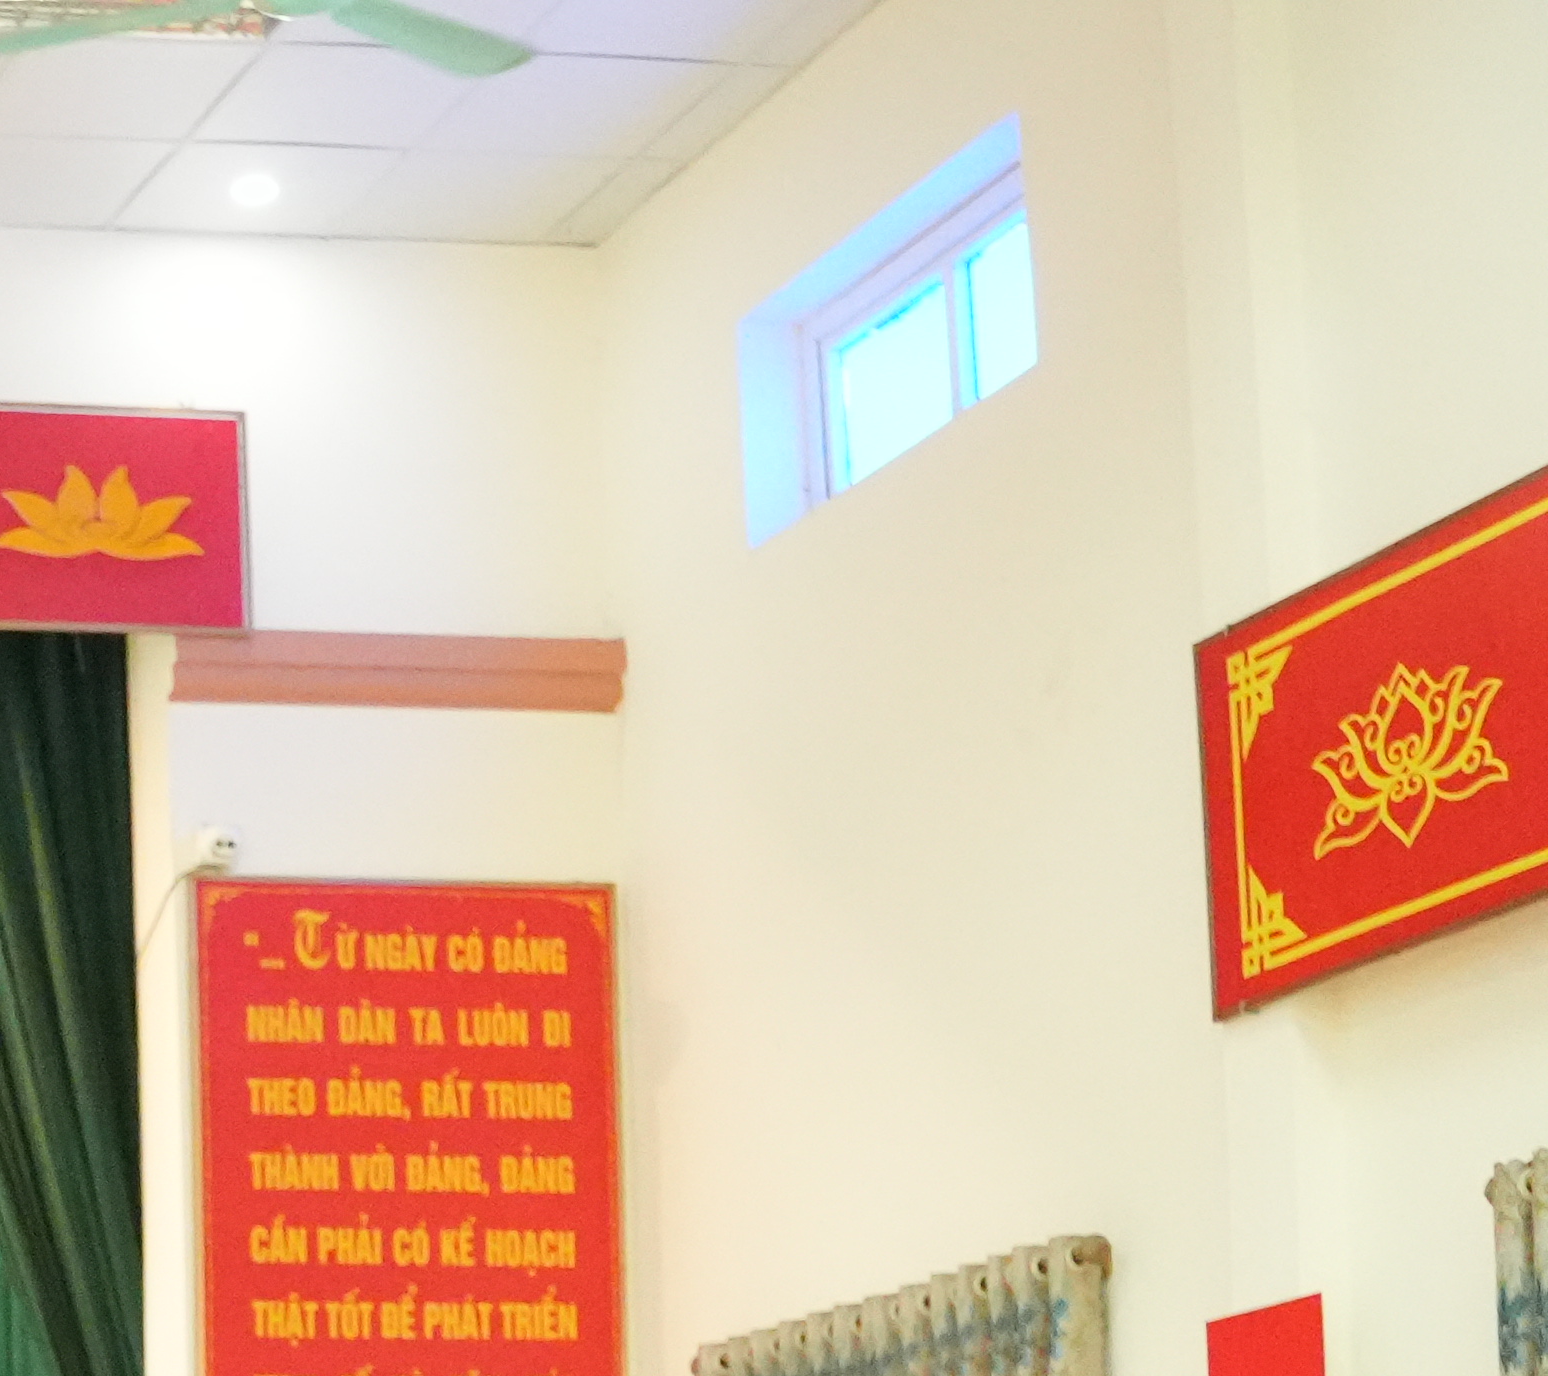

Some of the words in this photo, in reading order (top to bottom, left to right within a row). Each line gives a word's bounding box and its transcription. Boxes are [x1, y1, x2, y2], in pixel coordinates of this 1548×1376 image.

[365, 927, 436, 970] NGÀY
[493, 921, 566, 973] ĐẢNG
[247, 999, 323, 1042] NHÂN
[339, 1000, 395, 1044] DÂN
[409, 1008, 443, 1044] TA
[458, 1003, 528, 1046] LUÔN
[247, 1078, 316, 1115] THEO
[483, 1082, 572, 1119] TRUNG
[249, 1146, 339, 1189] THÀNH
[500, 1146, 575, 1193] ĐẢNG
[318, 1213, 382, 1264] PHẢI
[393, 1222, 429, 1266] CÓ
[486, 1230, 575, 1276] HOẠCH
[252, 1293, 318, 1345] THẬT
[326, 1290, 373, 1339] TỐT
[424, 1297, 492, 1339] PHÁT
[500, 1287, 577, 1340] TRIỂN
